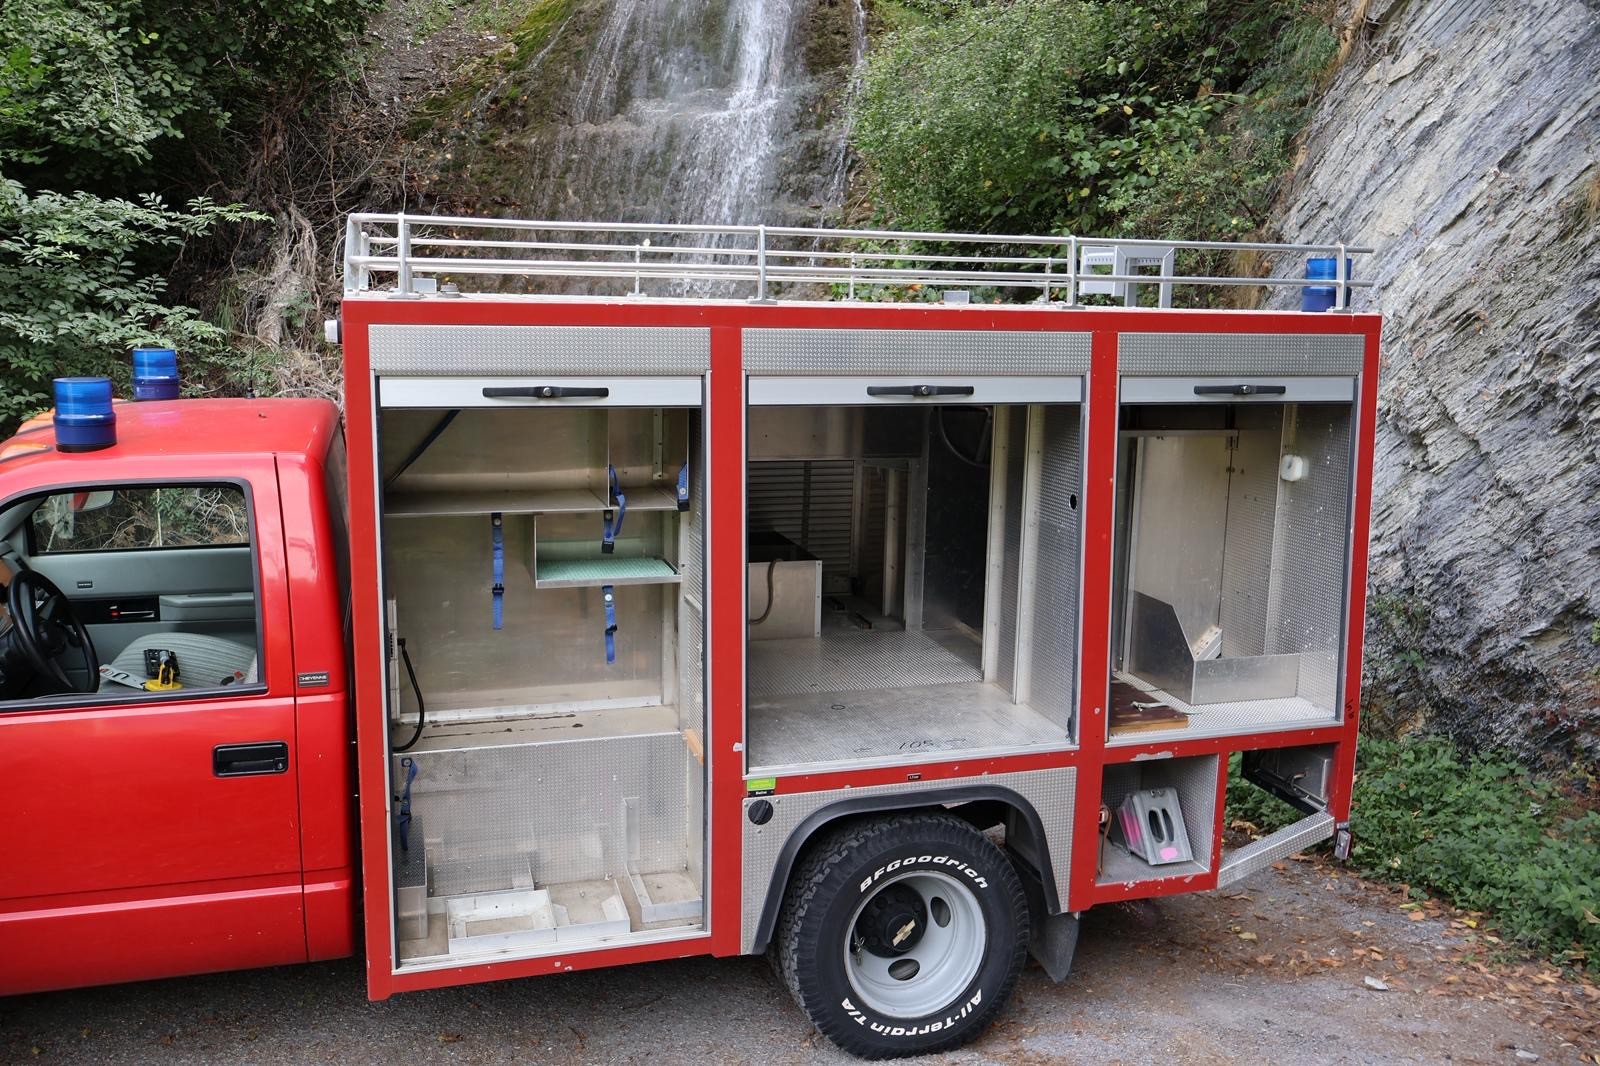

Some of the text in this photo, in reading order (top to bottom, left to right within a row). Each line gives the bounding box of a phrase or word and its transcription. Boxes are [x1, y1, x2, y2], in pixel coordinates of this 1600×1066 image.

[860, 855, 988, 893] BFGoodrich
[841, 988, 982, 1036] All-Terrain T/A
